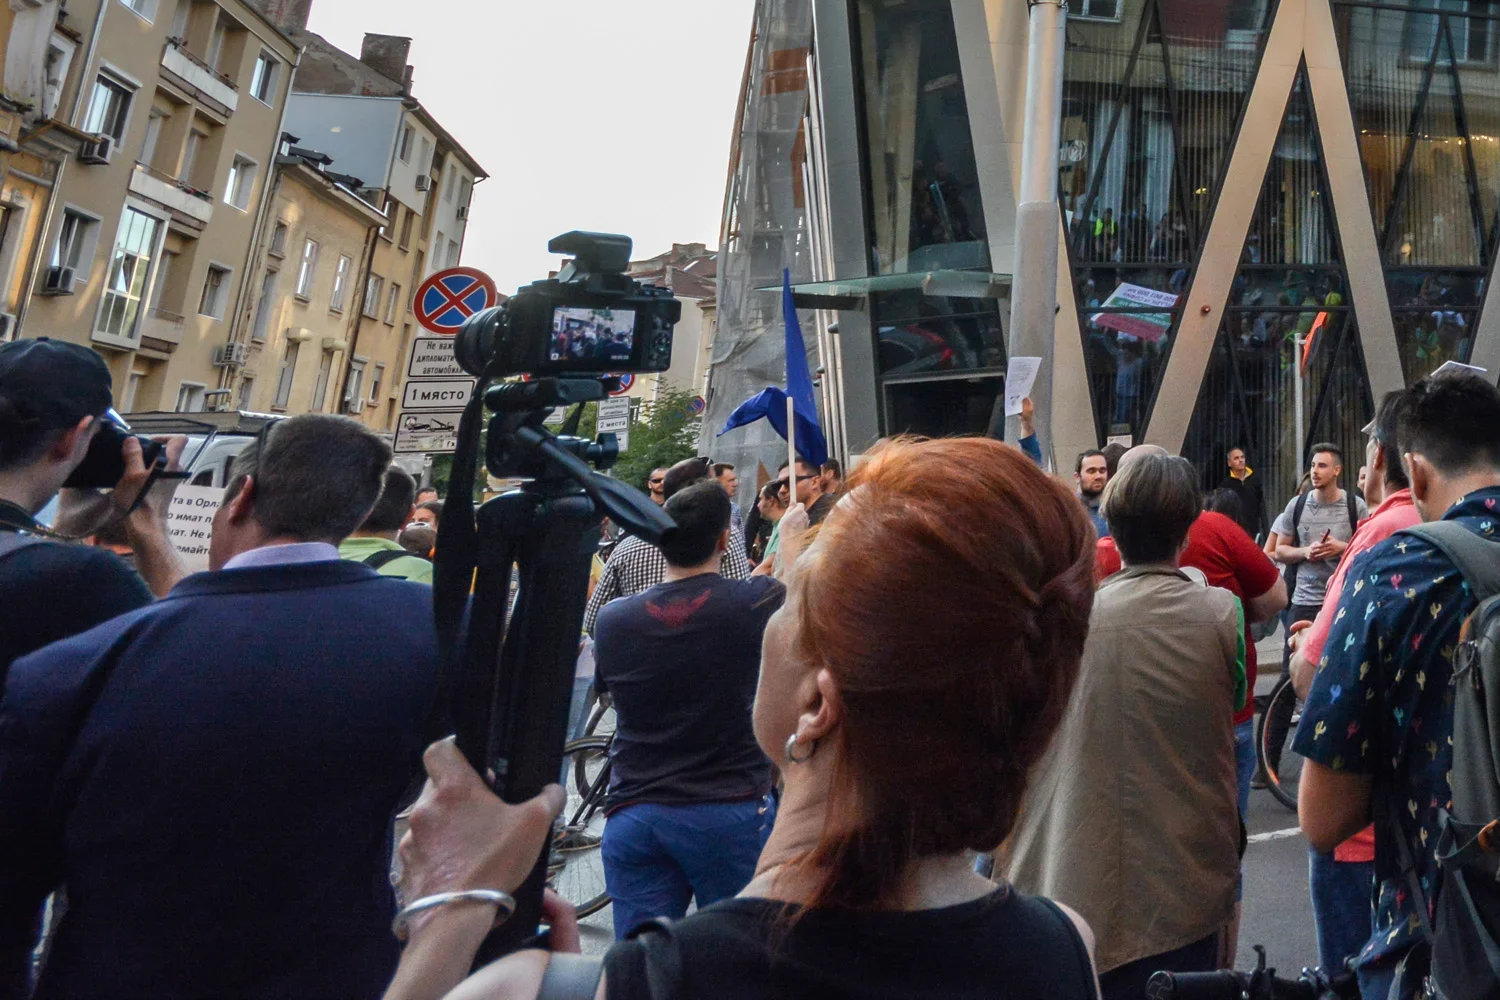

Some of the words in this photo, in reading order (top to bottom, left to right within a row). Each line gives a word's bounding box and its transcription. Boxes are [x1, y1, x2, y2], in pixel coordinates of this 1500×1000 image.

[426, 341, 436, 350] Не
[439, 342, 454, 350] важ
[416, 355, 455, 363] дипломати
[412, 389, 417, 401] 1
[173, 497, 183, 505] та
[175, 513, 203, 522] имат
[190, 529, 204, 539] Не
